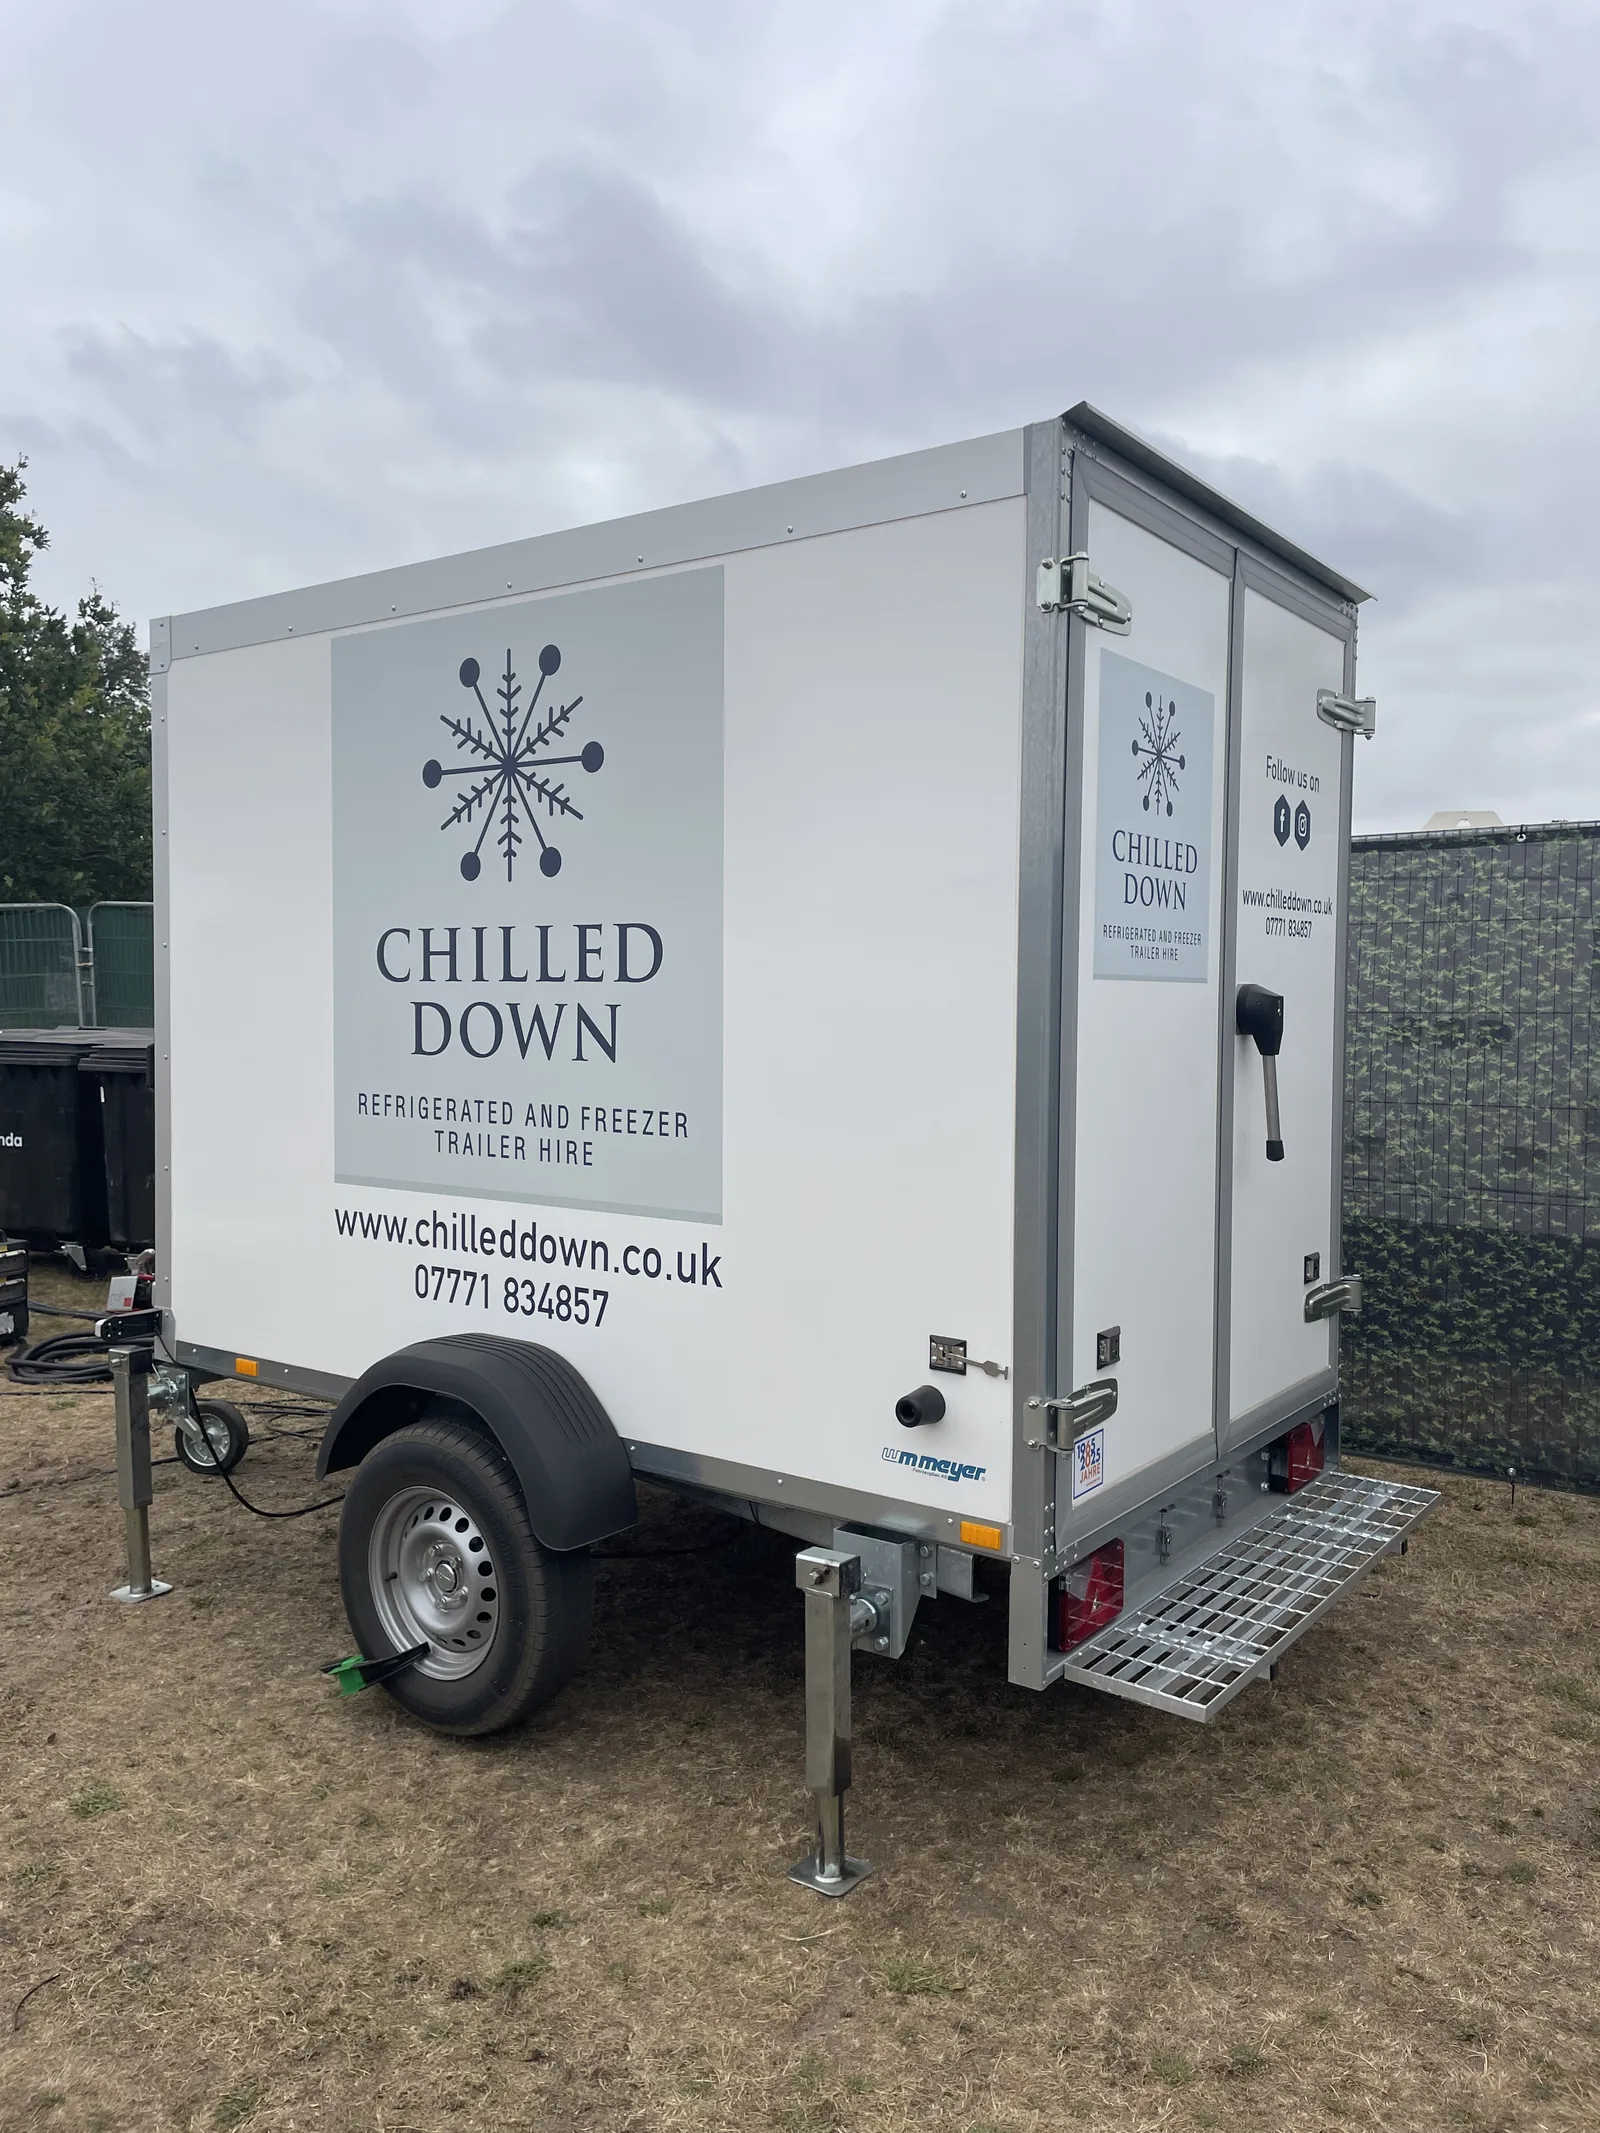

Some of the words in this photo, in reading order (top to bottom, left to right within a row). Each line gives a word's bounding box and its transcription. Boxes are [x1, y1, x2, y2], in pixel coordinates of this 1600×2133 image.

[1266, 754, 1296, 786] Follow
[1297, 771, 1308, 790] us
[1309, 775, 1320, 793] on
[1112, 829, 1198, 874] CHILLED
[1123, 872, 1187, 911] DOWN
[1242, 888, 1333, 915] www.chilleddown.co.uk
[1103, 924, 1157, 942] REFRIGERATED
[1159, 929, 1173, 944] AND
[1174, 931, 1202, 946] FREEZER
[1265, 917, 1286, 937] 07771
[1288, 919, 1312, 938] 834857
[376, 922, 664, 983] CHILLED
[1130, 945, 1160, 960] TRAILER
[1162, 947, 1179, 961] HIRE
[410, 1001, 622, 1064] DOWN
[358, 1092, 514, 1125] REFRIGERATED
[524, 1102, 570, 1130] AND
[581, 1106, 688, 1139] FREEZER
[434, 1130, 526, 1161] TRAILER
[539, 1138, 594, 1167] HIRE
[334, 1208, 723, 1288] www.chilleddown.co.uk
[414, 1263, 490, 1310] 07771
[503, 1276, 609, 1328] 834857
[1080, 1463, 1101, 1484] JAHRE
